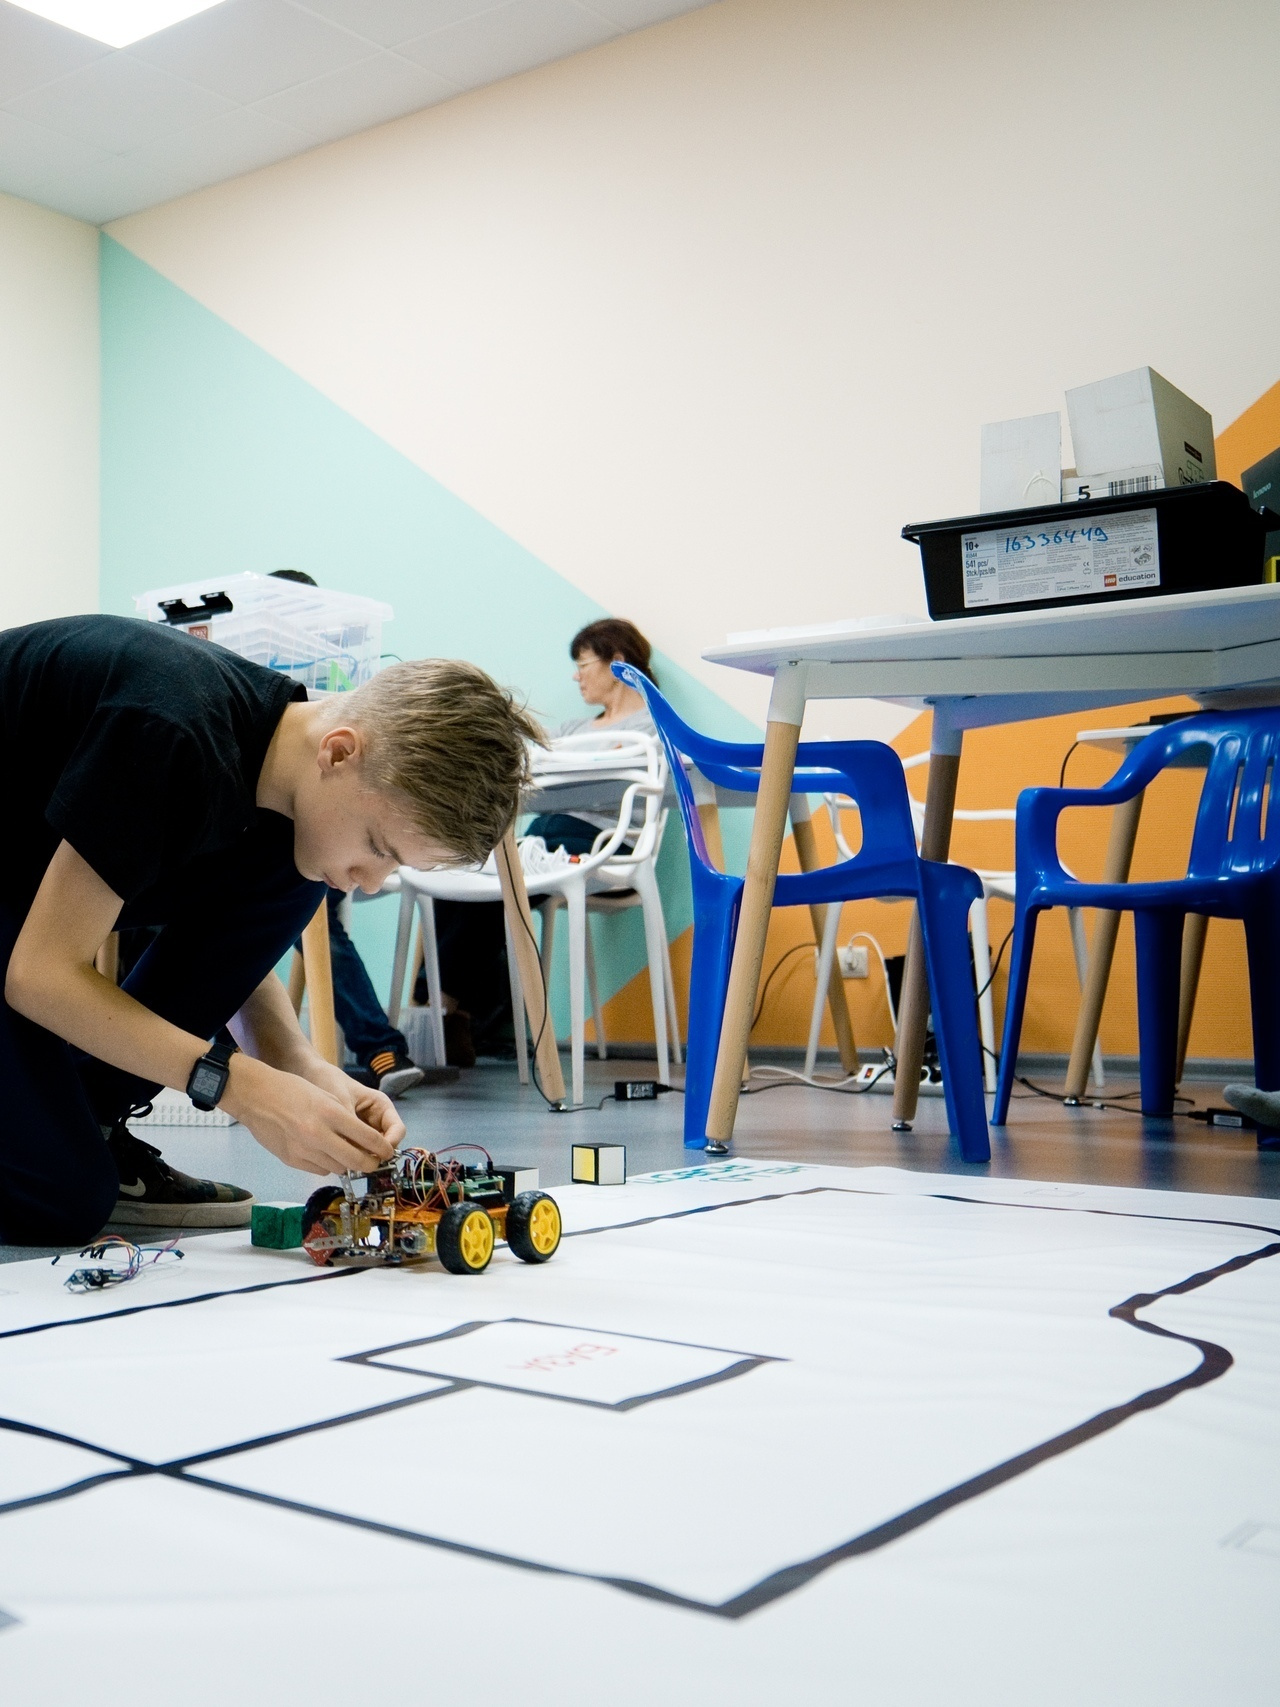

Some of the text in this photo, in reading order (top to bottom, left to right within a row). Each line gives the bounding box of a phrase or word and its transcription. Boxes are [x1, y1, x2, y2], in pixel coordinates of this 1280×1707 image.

[1078, 485, 1091, 500] 5
[965, 541, 979, 551] 10+
[965, 560, 976, 568] 541
[1118, 572, 1156, 583] education
